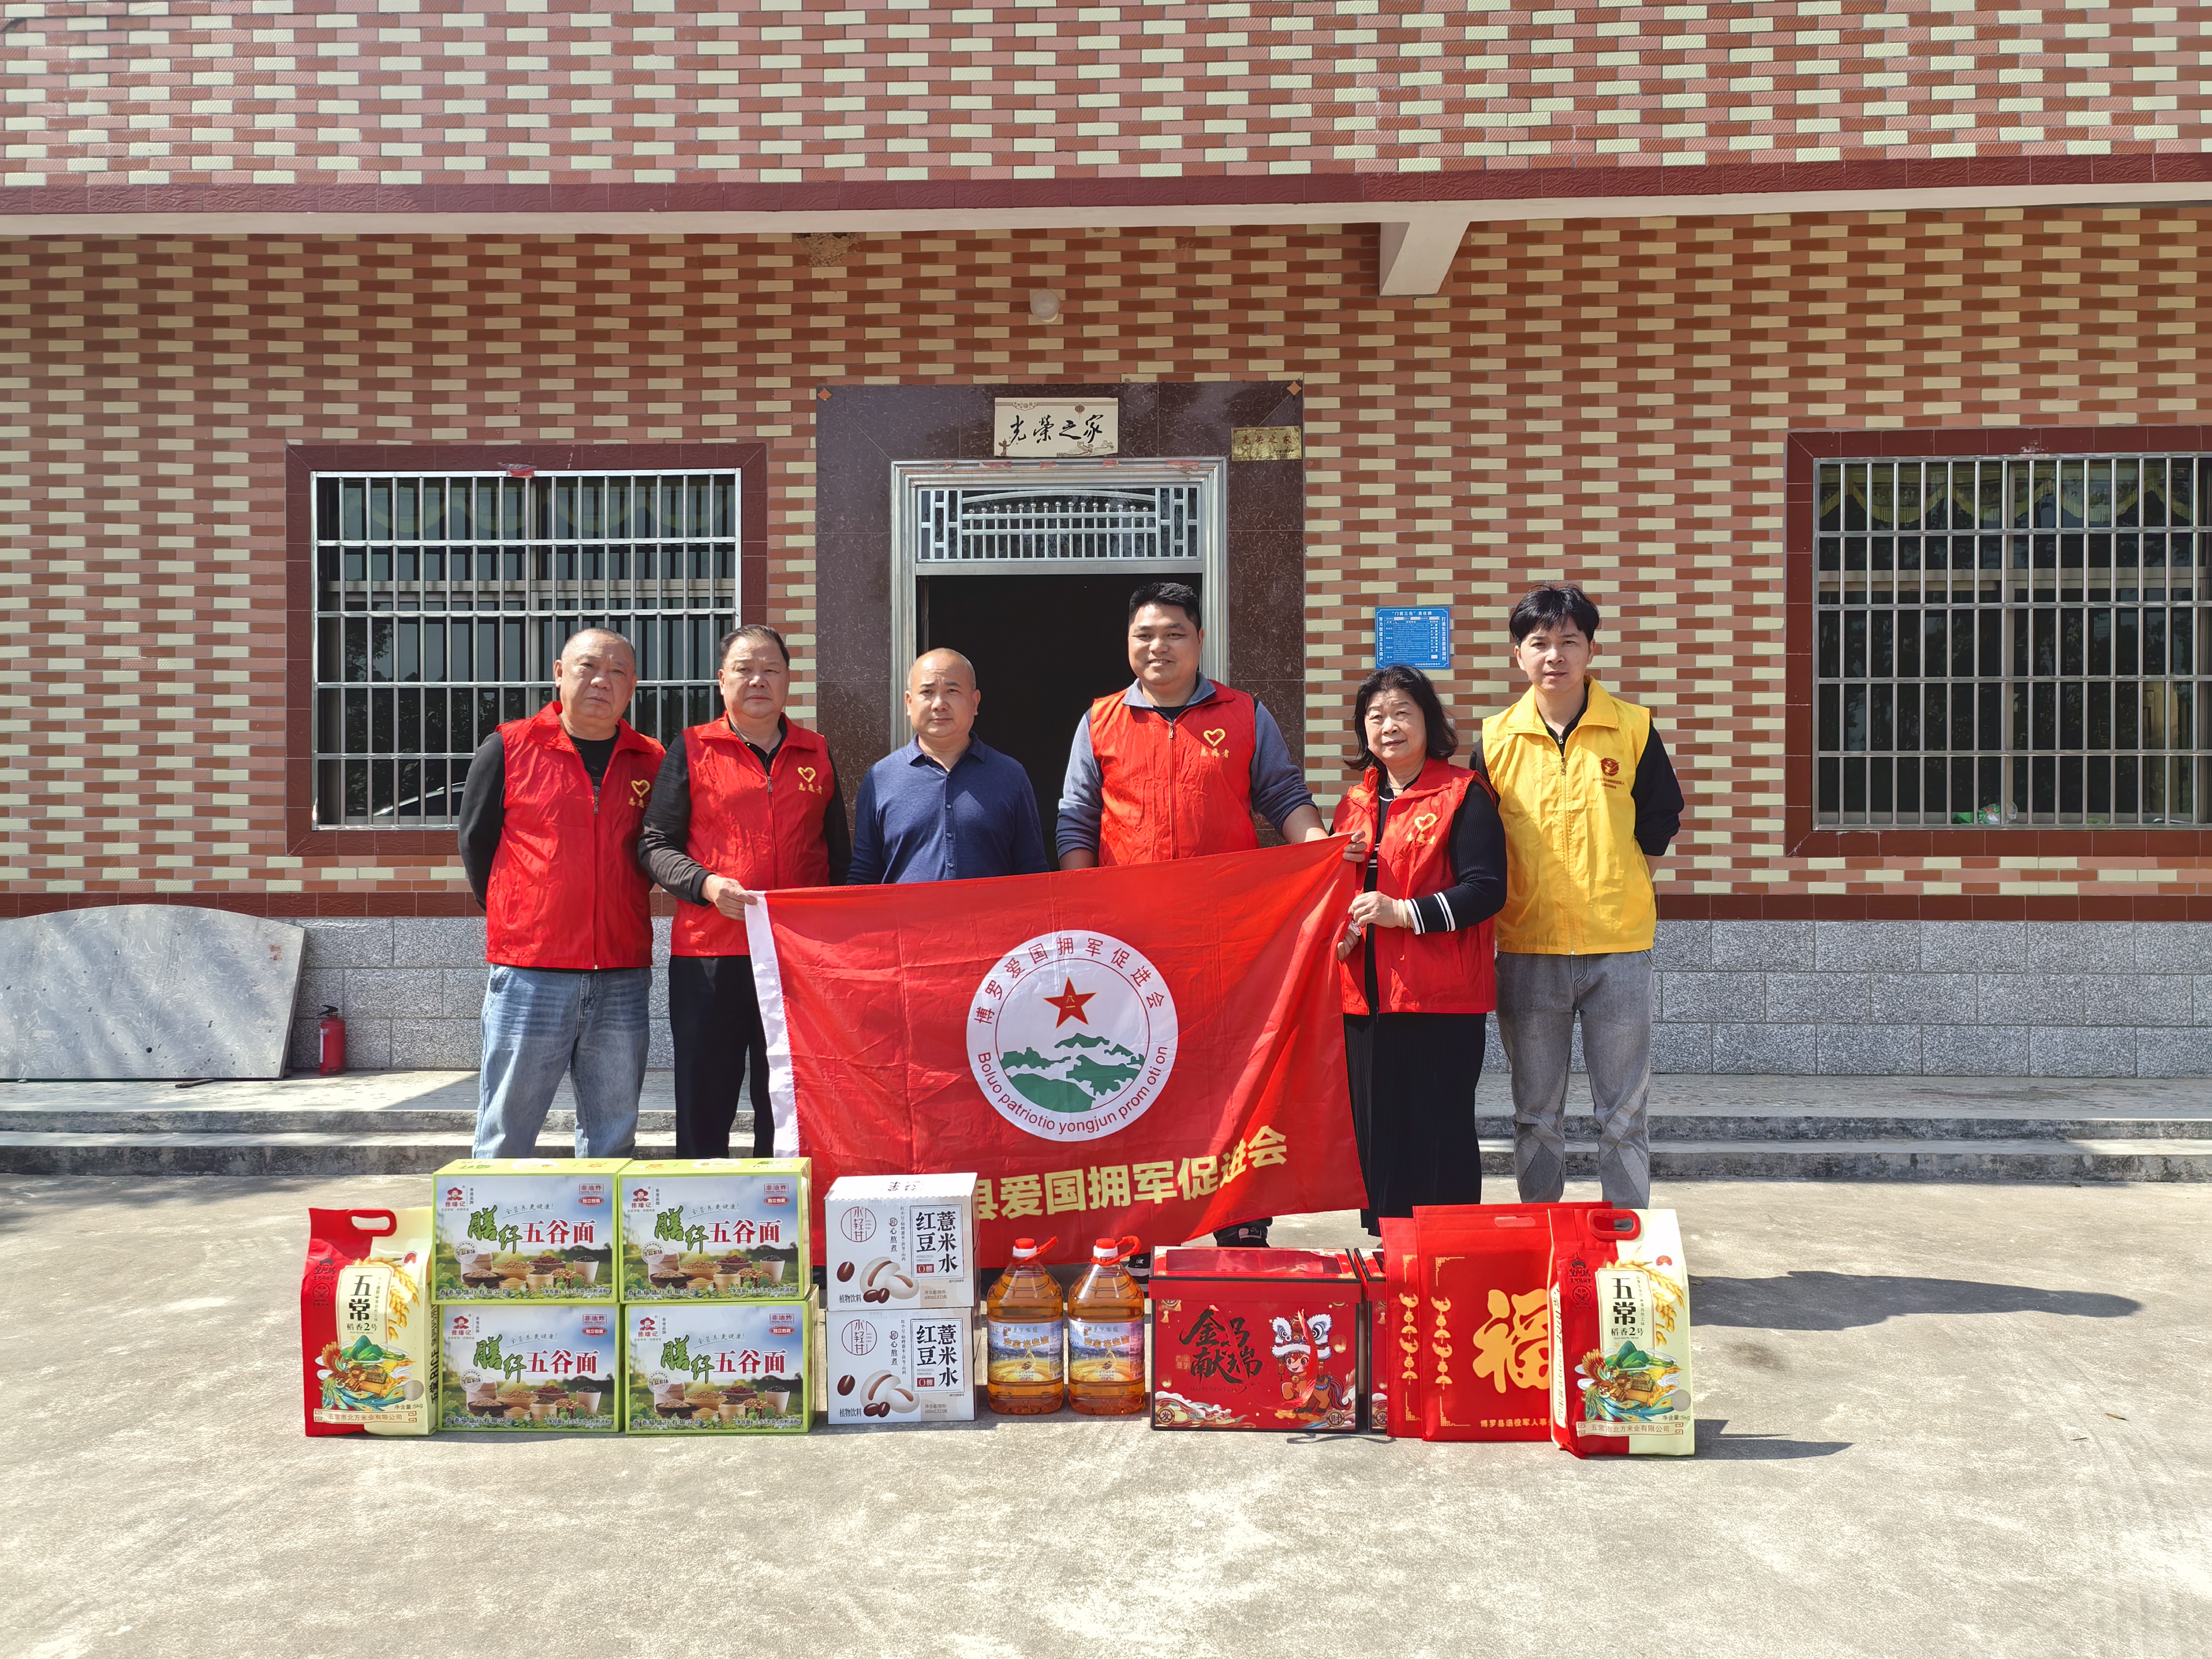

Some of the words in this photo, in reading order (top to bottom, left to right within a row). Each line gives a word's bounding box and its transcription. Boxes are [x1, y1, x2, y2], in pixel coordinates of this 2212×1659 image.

[974, 937, 1165, 1024] 博罗爱国拥军促进会
[978, 1052, 1003, 1094] Boluo
[1059, 1112, 1117, 1135] yongjun
[916, 1212, 936, 1252] 红豆
[937, 1211, 959, 1273] 薏米水
[349, 1275, 373, 1321] 五常
[839, 1294, 862, 1303] 植物饮料
[1611, 1278, 1636, 1325] 五常
[347, 1323, 377, 1331] 稻香2号
[916, 1325, 936, 1366] 红豆
[1473, 1289, 1549, 1393] 福
[1611, 1327, 1644, 1336] 稻香2号
[937, 1325, 959, 1387] 薏米水
[840, 1408, 862, 1418] 植物饮料
[1161, 1411, 1171, 1421] 发
[1331, 1413, 1341, 1424] 财
[1480, 1418, 1550, 1428] 博罗县退役军人事
[1591, 1425, 1669, 1433] 五常市北方米业有限公司
